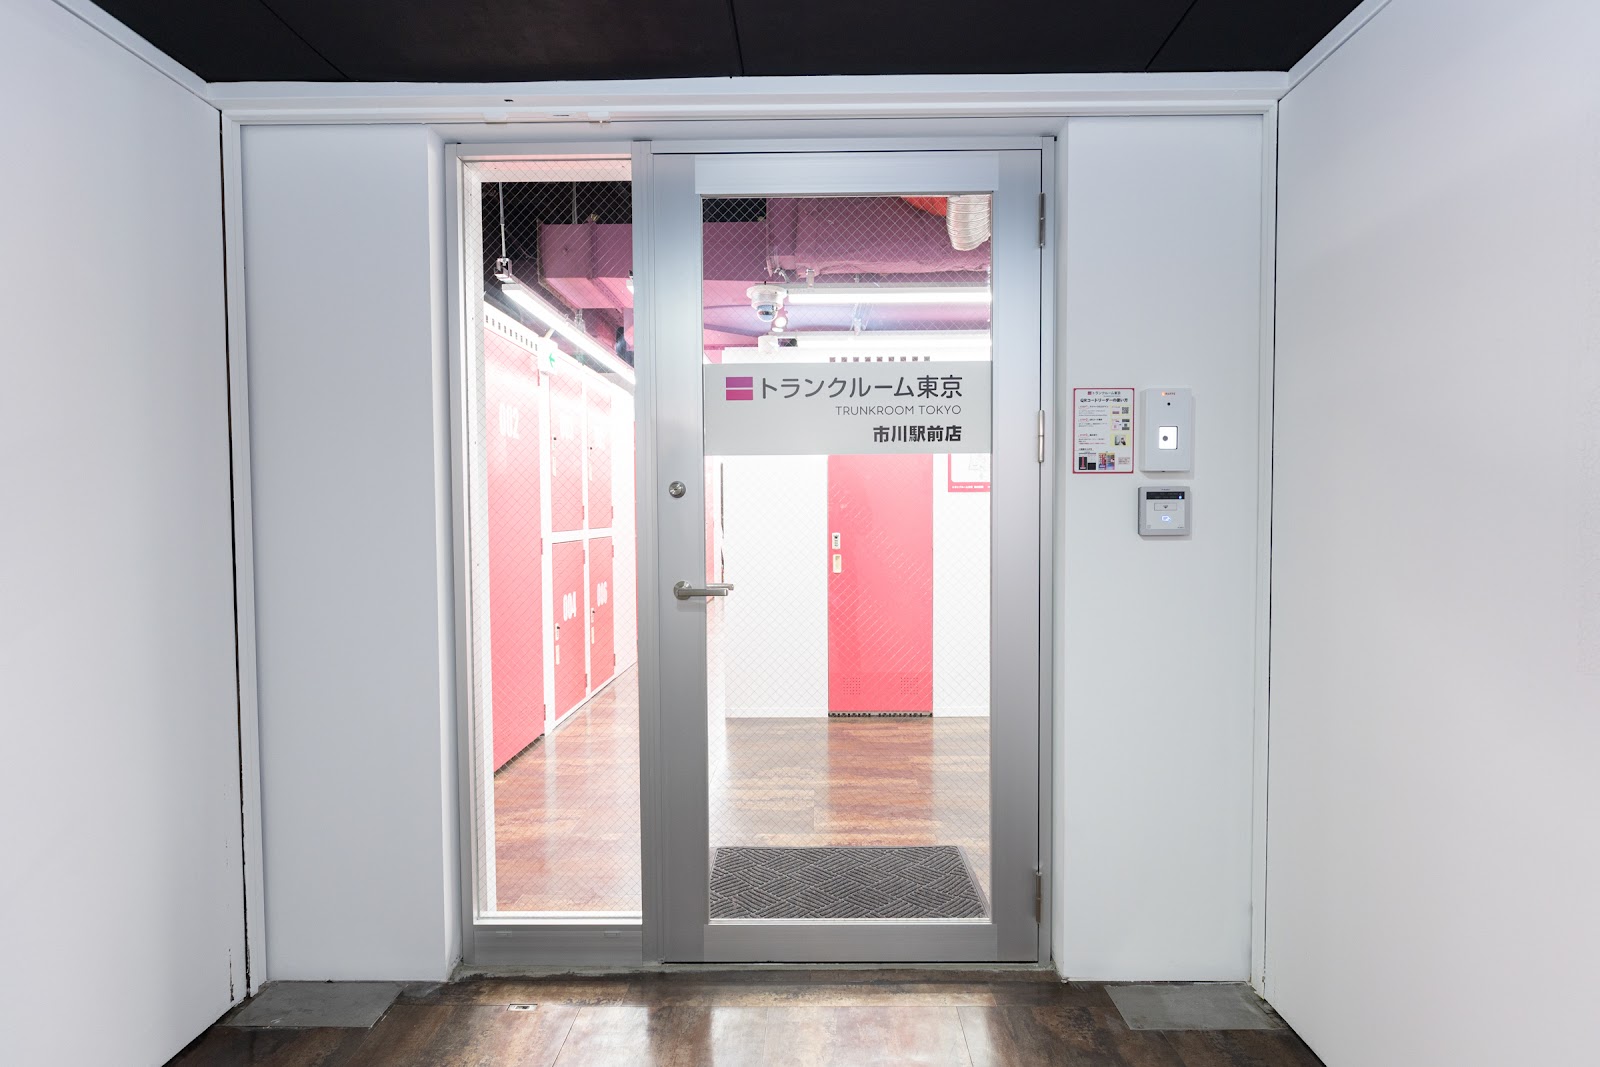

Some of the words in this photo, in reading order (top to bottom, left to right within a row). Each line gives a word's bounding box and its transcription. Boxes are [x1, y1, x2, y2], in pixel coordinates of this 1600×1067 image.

[761, 374, 963, 399] トランクルーム東京
[835, 405, 914, 416] TRUNKROOM
[918, 404, 962, 415] TOKYO
[872, 425, 962, 443] 市川駅前店
